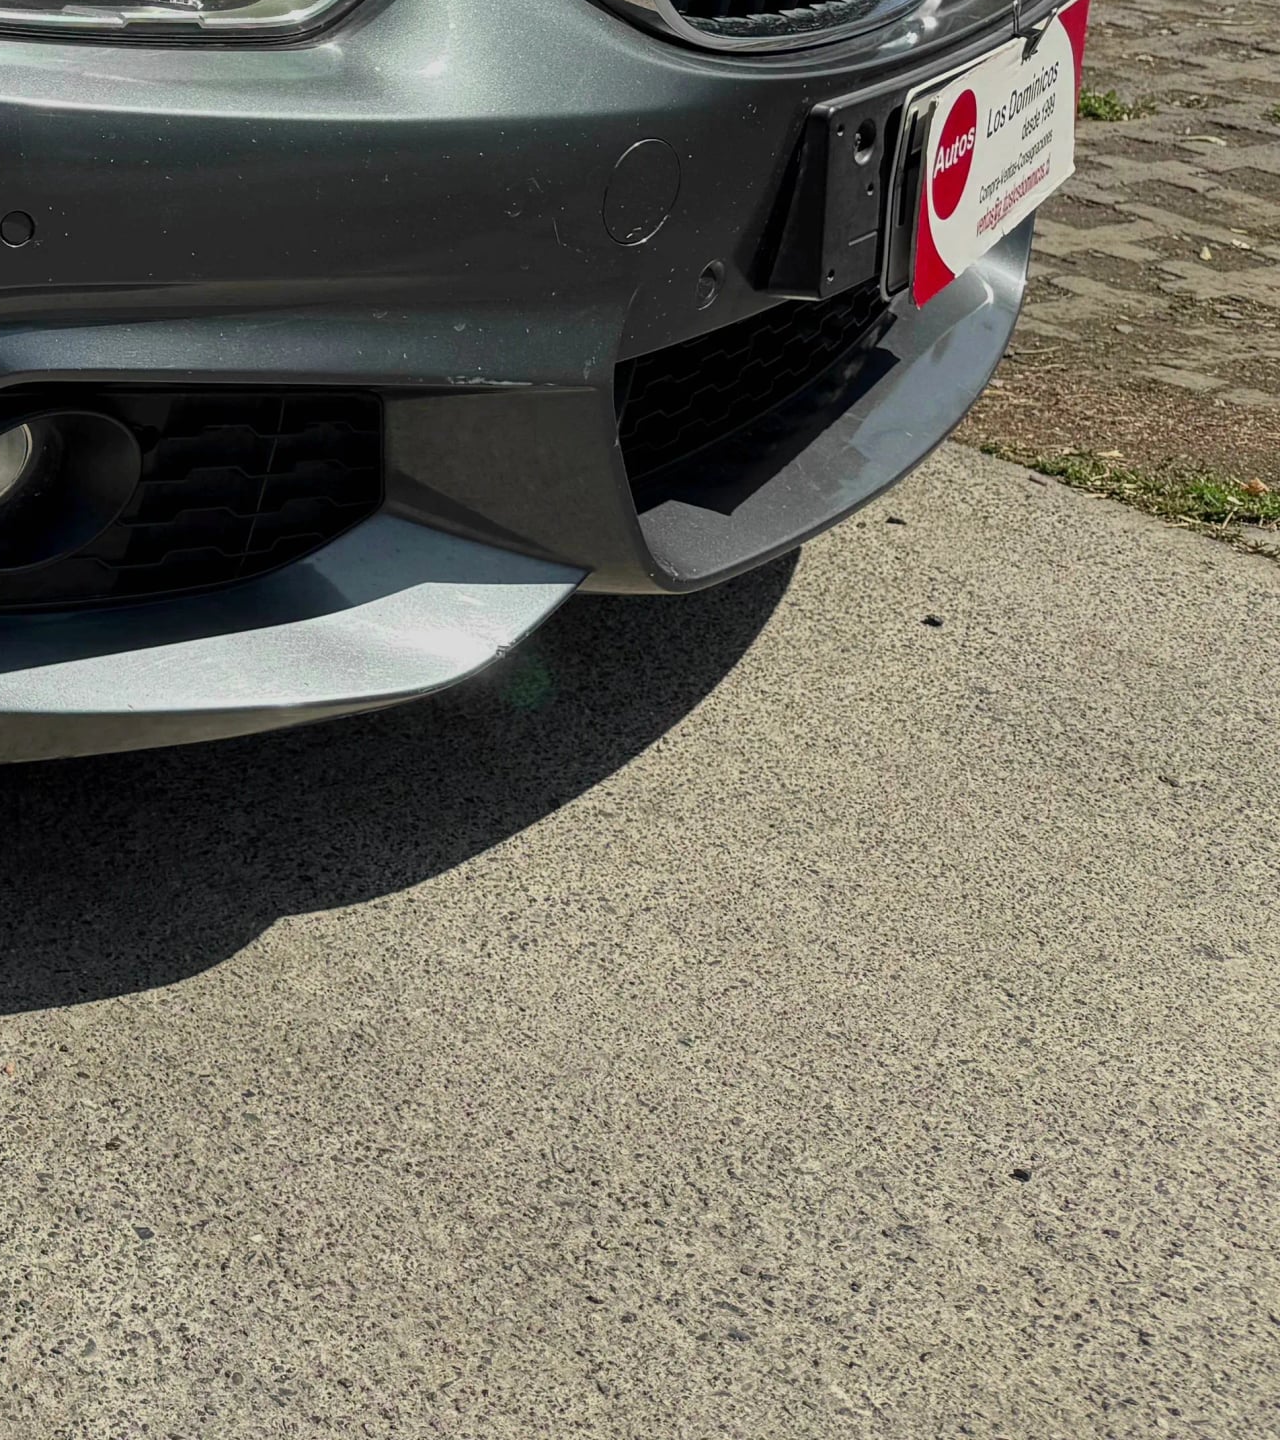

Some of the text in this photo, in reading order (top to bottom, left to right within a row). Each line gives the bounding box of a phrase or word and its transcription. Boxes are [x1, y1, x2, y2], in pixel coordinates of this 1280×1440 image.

[986, 61, 1059, 139] Los Dominicos
[1021, 107, 1040, 140] desde
[933, 126, 976, 179] Autos
